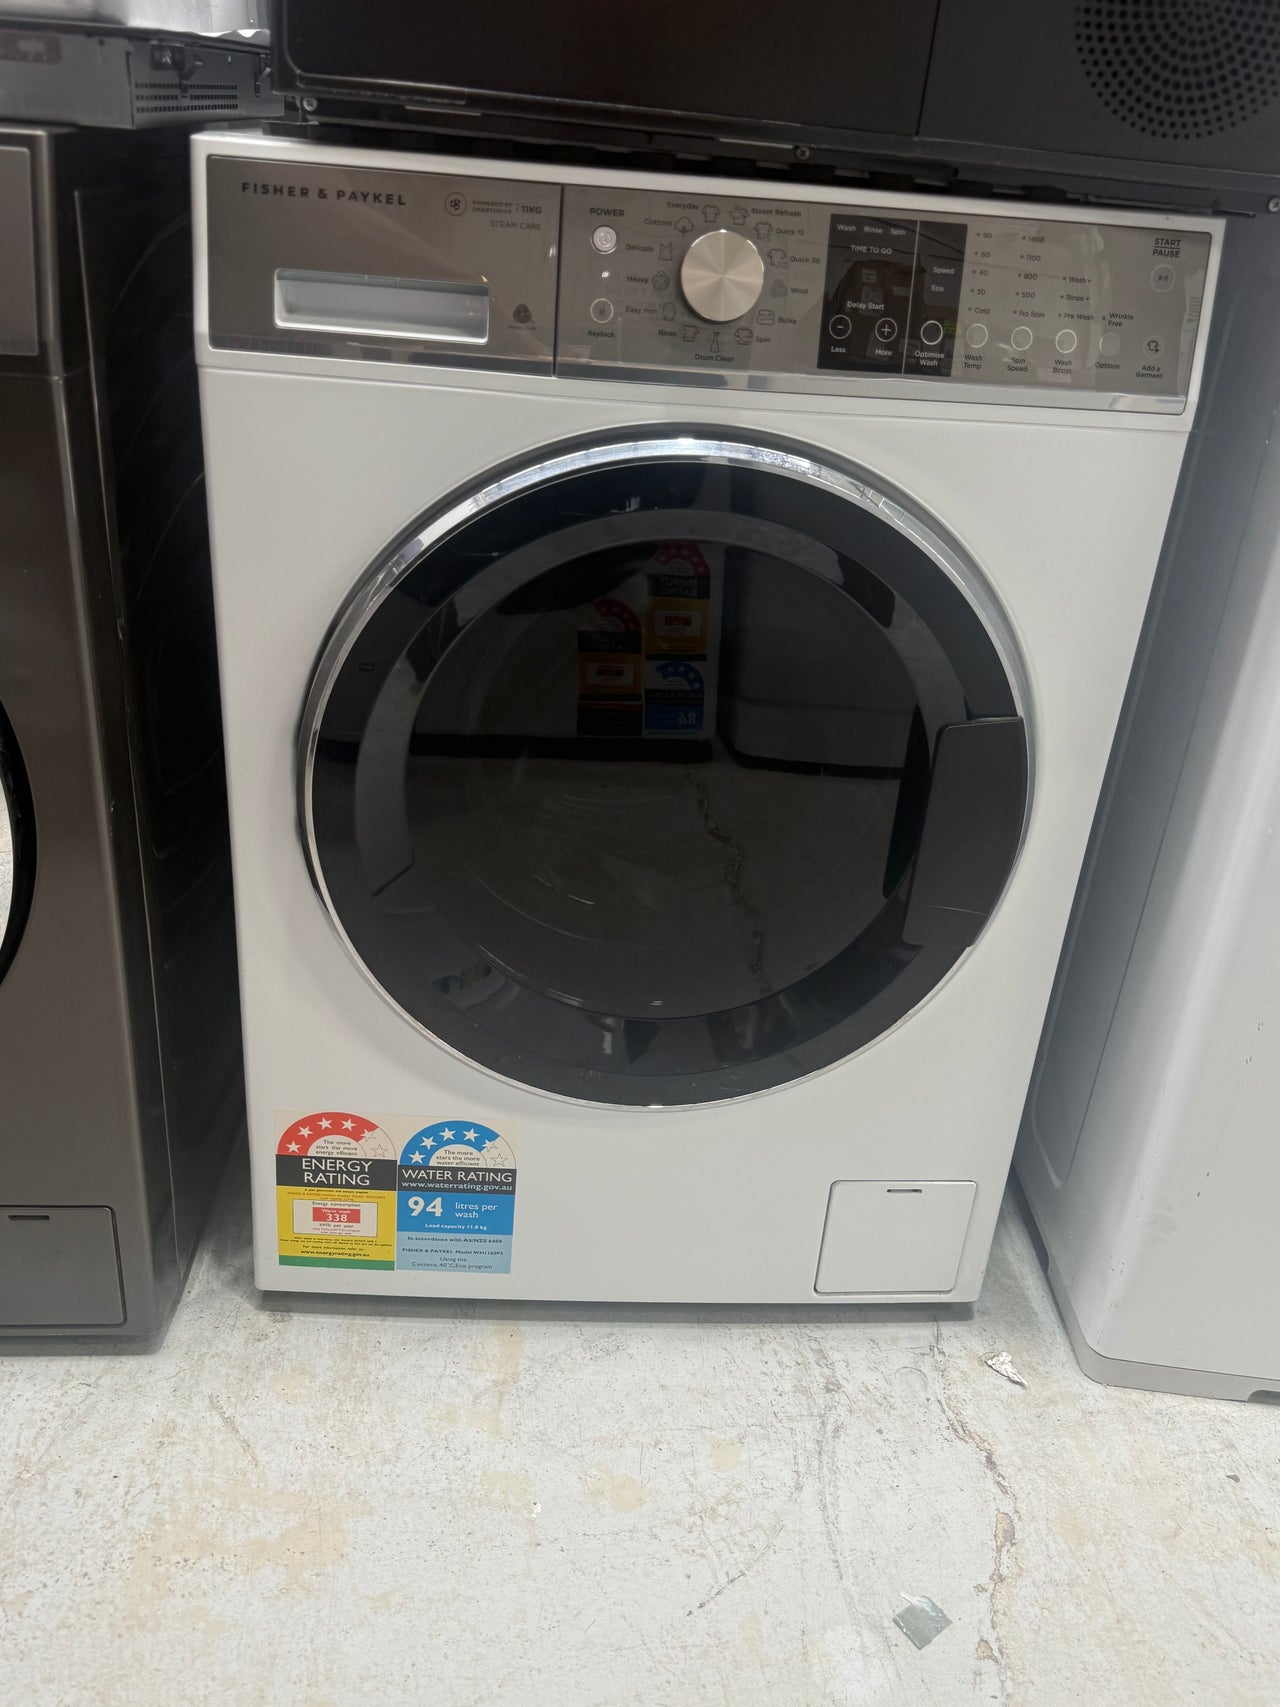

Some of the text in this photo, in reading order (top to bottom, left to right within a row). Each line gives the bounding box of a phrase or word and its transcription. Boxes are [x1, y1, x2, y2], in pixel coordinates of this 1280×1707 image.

[241, 182, 406, 206] FISHER & PAYKEL
[522, 205, 542, 214] 11KG
[667, 202, 700, 210] Everyday
[590, 208, 625, 217] POWER
[775, 209, 802, 217] Refresh
[489, 220, 542, 232] STEAM CARE
[644, 218, 673, 226] Cottons
[864, 226, 882, 234] Rinse
[890, 228, 906, 236] Spin
[1154, 238, 1182, 246] START
[626, 244, 654, 252] Delicate
[1152, 248, 1180, 258] PAUSE
[790, 256, 810, 264] Quick
[932, 266, 954, 275] Speed
[627, 276, 650, 284] Heavy
[846, 301, 885, 310] Delay Start
[626, 306, 641, 314] Easy
[1031, 311, 1046, 319] Spin
[1109, 312, 1134, 320] Wrinkle
[587, 330, 615, 338] Keylock
[658, 329, 678, 337] Rinse
[914, 350, 944, 358] Optimise
[1094, 362, 1120, 370] Options
[1136, 372, 1163, 380] Garment
[302, 1158, 372, 1172] ENERGY
[304, 1172, 370, 1186] RATING
[402, 1169, 512, 1182] WATER RATING
[402, 1182, 512, 1191] www.waterrating.gov.au
[408, 1196, 443, 1217] 94
[455, 1202, 478, 1210] litres
[326, 1214, 348, 1222] 338
